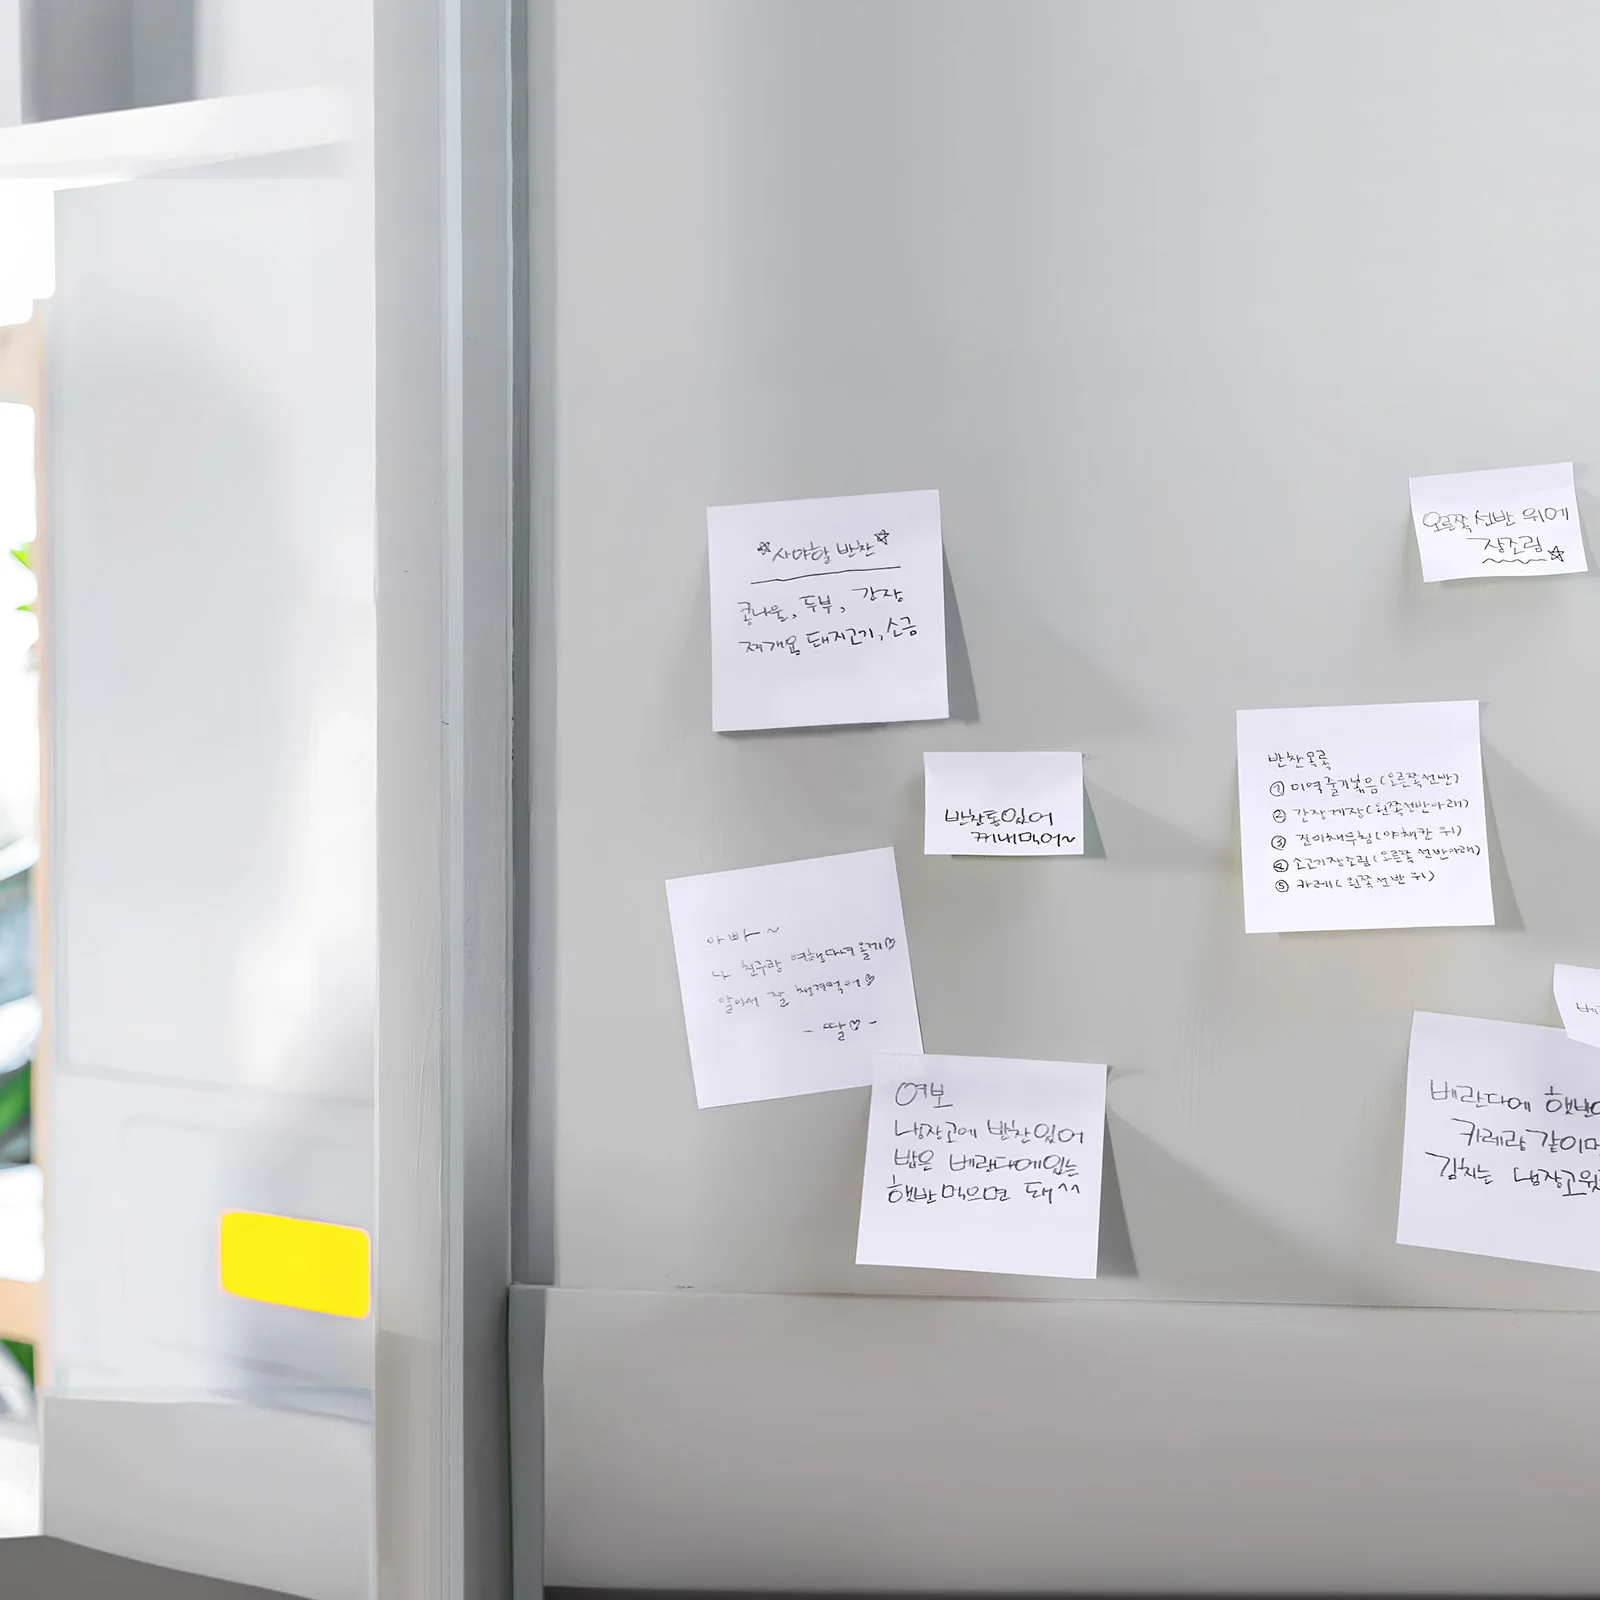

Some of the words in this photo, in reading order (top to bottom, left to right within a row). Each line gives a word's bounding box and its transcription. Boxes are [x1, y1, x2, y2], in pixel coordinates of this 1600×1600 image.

[1521, 506, 1569, 523] 위에
[771, 541, 832, 565] 사야할
[835, 538, 876, 558] 반찬
[1466, 535, 1544, 556] 장조림
[851, 585, 904, 603] 간장
[886, 616, 918, 638] 소금
[894, 1081, 954, 1109] 여보
[1429, 1078, 1532, 1113] 베란다에
[894, 1119, 978, 1144] 냉장고에
[893, 1148, 935, 1172] 밥은
[1424, 1151, 1494, 1186] 김치는
